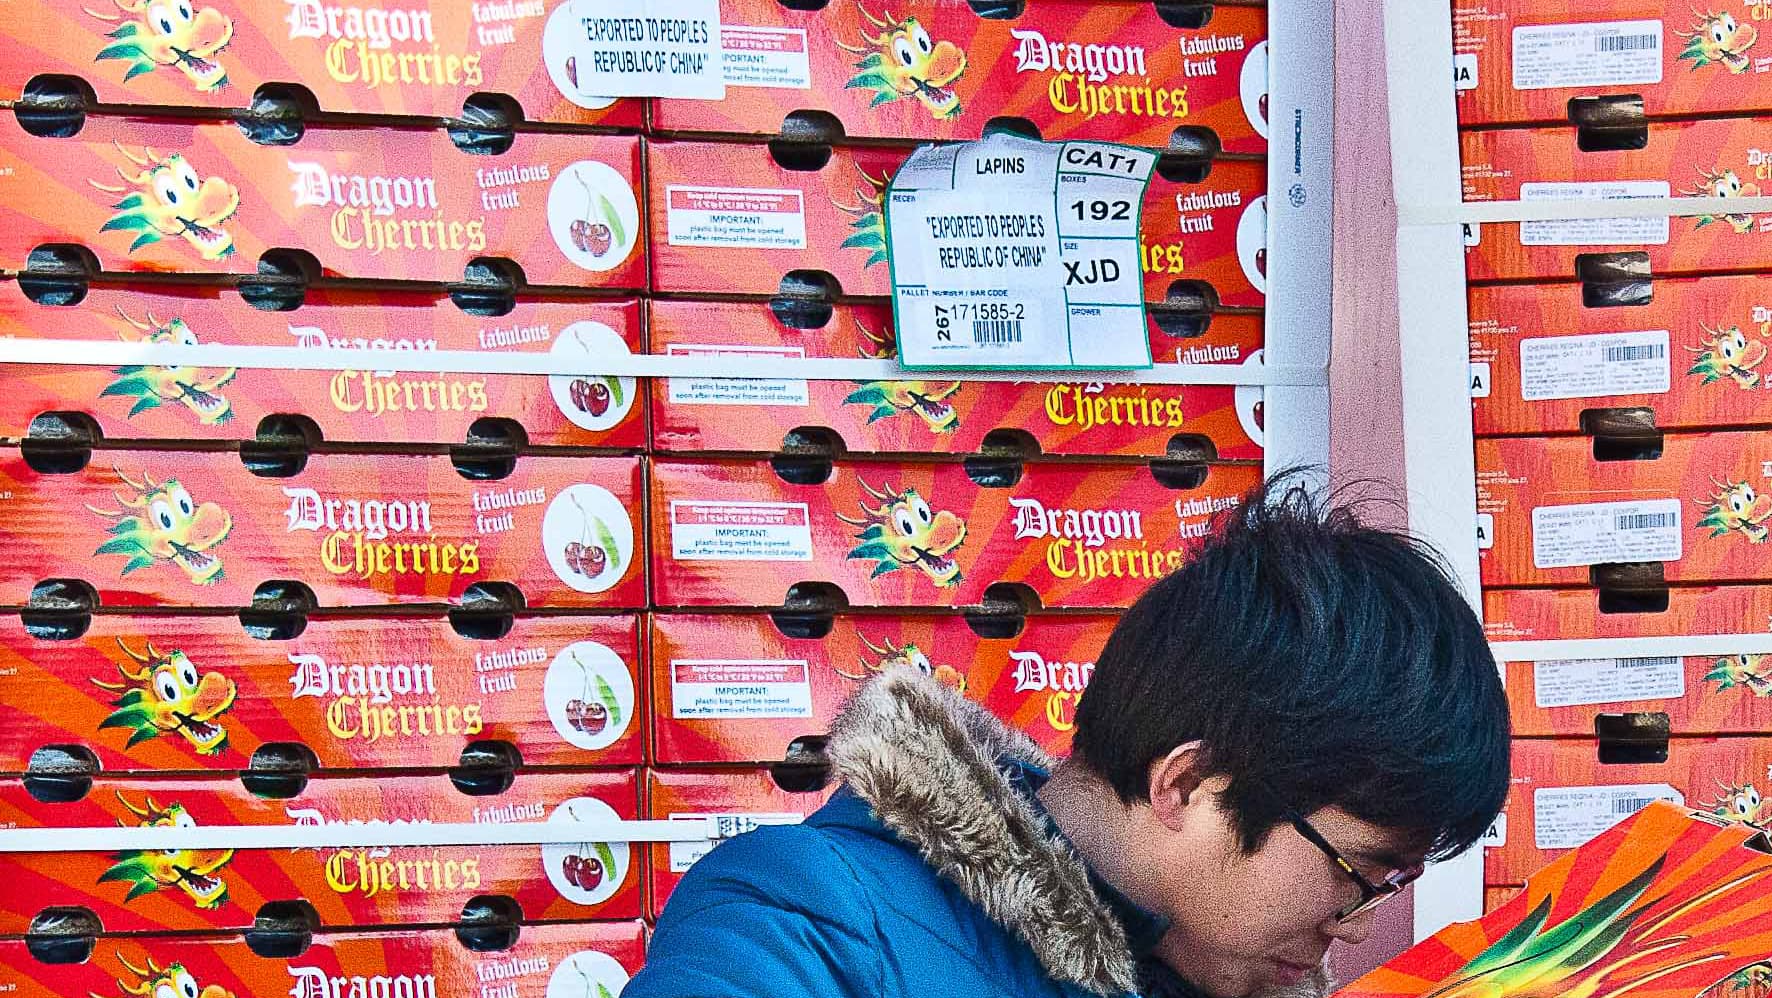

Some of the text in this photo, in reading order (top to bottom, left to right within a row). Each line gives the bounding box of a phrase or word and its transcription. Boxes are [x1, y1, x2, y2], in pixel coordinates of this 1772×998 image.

[645, 18, 658, 42] TO
[1012, 29, 1146, 82] Dragon
[1180, 35, 1244, 55] fabulous
[594, 51, 653, 73] REPUBLIC
[654, 52, 666, 73] OF
[1183, 55, 1216, 77] fruit
[1049, 71, 1188, 118] Cherries
[976, 158, 1025, 175] LAPINS
[1065, 148, 1138, 173] CAT1
[288, 160, 438, 215] Dragon
[476, 164, 549, 187] fabulous
[1061, 175, 1087, 183] BOXES
[481, 189, 519, 211] fruit
[1071, 200, 1131, 221] 192
[1176, 191, 1240, 211] fabulous
[331, 210, 485, 255] Cherries
[985, 215, 998, 238] TO
[1179, 210, 1213, 233] fruit
[939, 247, 993, 269] REPUBLIC
[995, 249, 1009, 268] OF
[1063, 258, 1120, 286] XJD
[901, 289, 929, 297] PALLET
[935, 305, 951, 341] 267
[950, 304, 1025, 320] 171585-2
[330, 371, 488, 416] Cherries
[1046, 379, 1183, 429] Cherries
[473, 487, 546, 512] fabulous
[283, 487, 432, 539] Dragon
[476, 511, 514, 534] fruit
[1009, 497, 1142, 546] Dragon
[320, 532, 479, 580] Cherries
[475, 648, 547, 672] fabulous
[288, 652, 436, 704] Dragon
[479, 671, 516, 694] fruit
[327, 696, 482, 741] Cherries
[326, 849, 481, 895] Cherries
